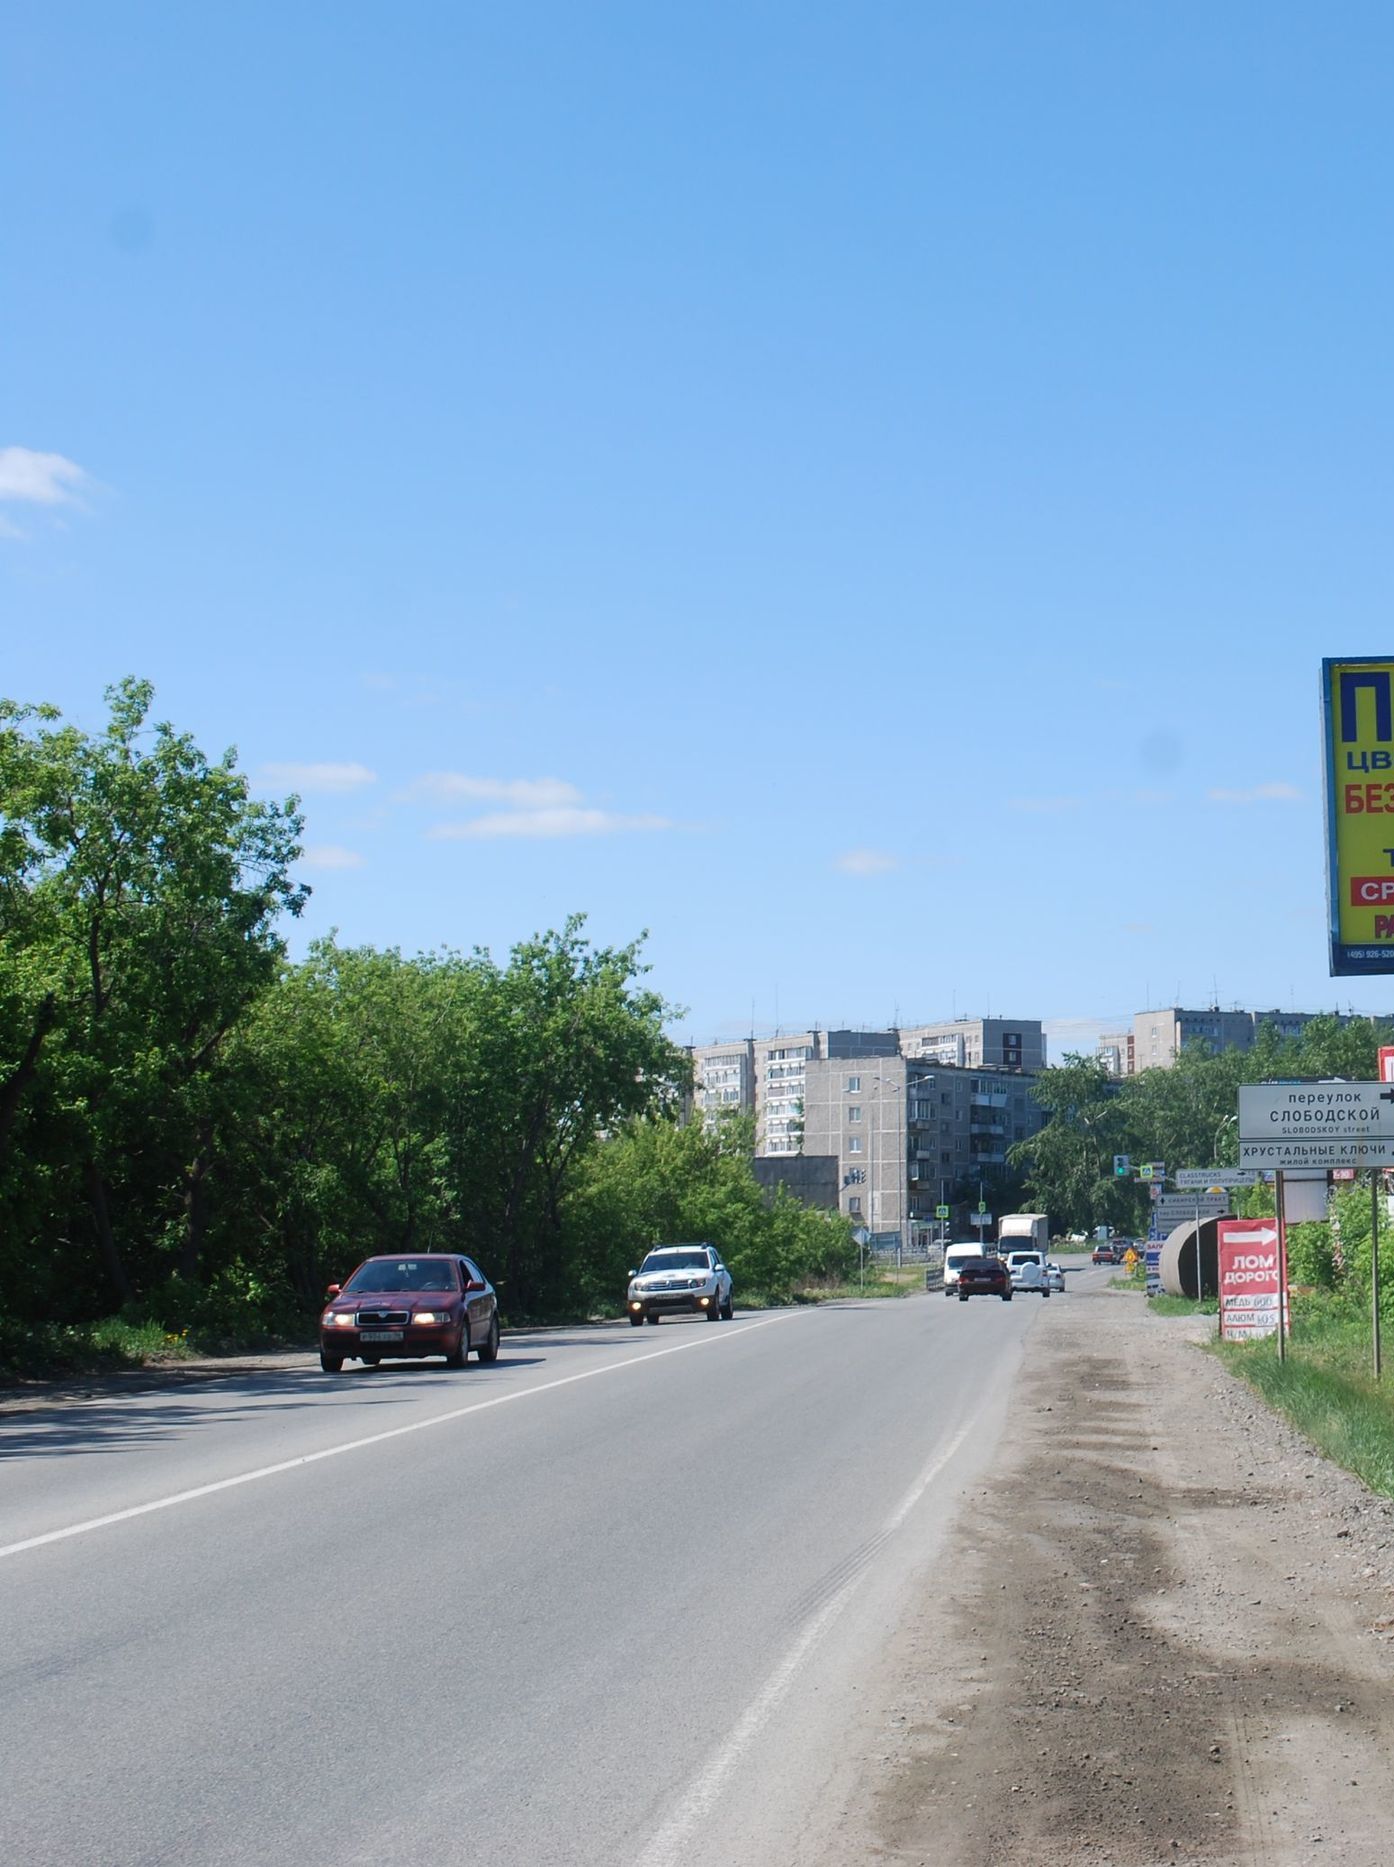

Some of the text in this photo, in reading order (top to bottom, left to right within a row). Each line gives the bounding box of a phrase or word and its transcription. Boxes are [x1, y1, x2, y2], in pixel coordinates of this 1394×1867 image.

[1288, 1093, 1362, 1106] переулок
[1270, 1106, 1380, 1123] СЛОБОДСКОЙ
[1282, 1126, 1371, 1134] SLOBODSKOY street
[1243, 1145, 1386, 1157] ХРУСТАЛЬНЫЕ КЛЮЧИ
[1279, 1157, 1357, 1166] жилой комплекс
[1232, 1254, 1275, 1270] ЛОМ
[1224, 1270, 1279, 1285] ДОРОГО
